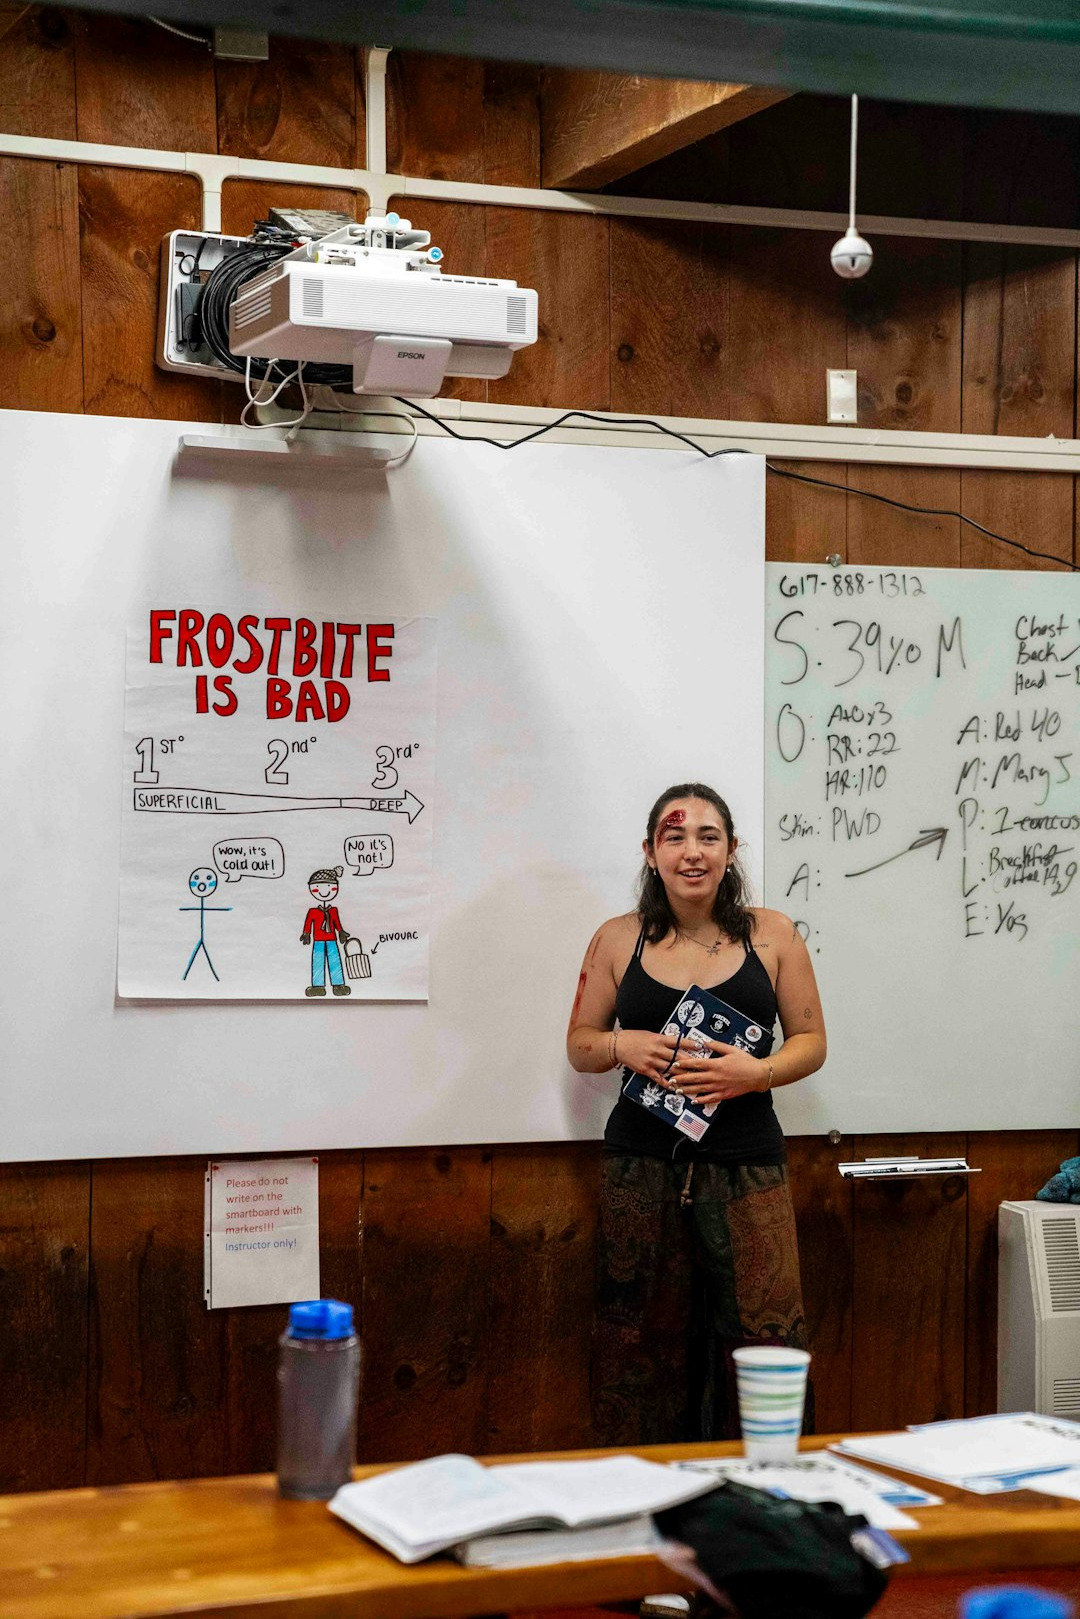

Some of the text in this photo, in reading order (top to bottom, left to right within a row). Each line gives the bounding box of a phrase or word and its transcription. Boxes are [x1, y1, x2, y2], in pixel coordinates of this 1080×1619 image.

[397, 351, 426, 360] EPSON
[779, 573, 926, 598] 617-888-1312
[149, 609, 395, 683] FROSTBITE
[936, 616, 966, 678] M
[1015, 669, 1047, 695] Head
[195, 675, 351, 723] IS BAD
[957, 707, 1062, 745] A: Red 40
[137, 793, 227, 812] SUPERFICIAL
[369, 799, 403, 811] DEEP
[832, 806, 881, 842] PWD
[249, 846, 267, 857] it's
[370, 839, 387, 851] it's
[358, 852, 384, 866] not!
[965, 901, 989, 938] E:
[379, 931, 419, 943] BIVOUAC
[226, 1176, 288, 1188] Please do not
[226, 1191, 283, 1204] write on the
[225, 1205, 302, 1219] smartboard with
[225, 1222, 274, 1235] markers!!!
[225, 1238, 297, 1252] Instructor only!
